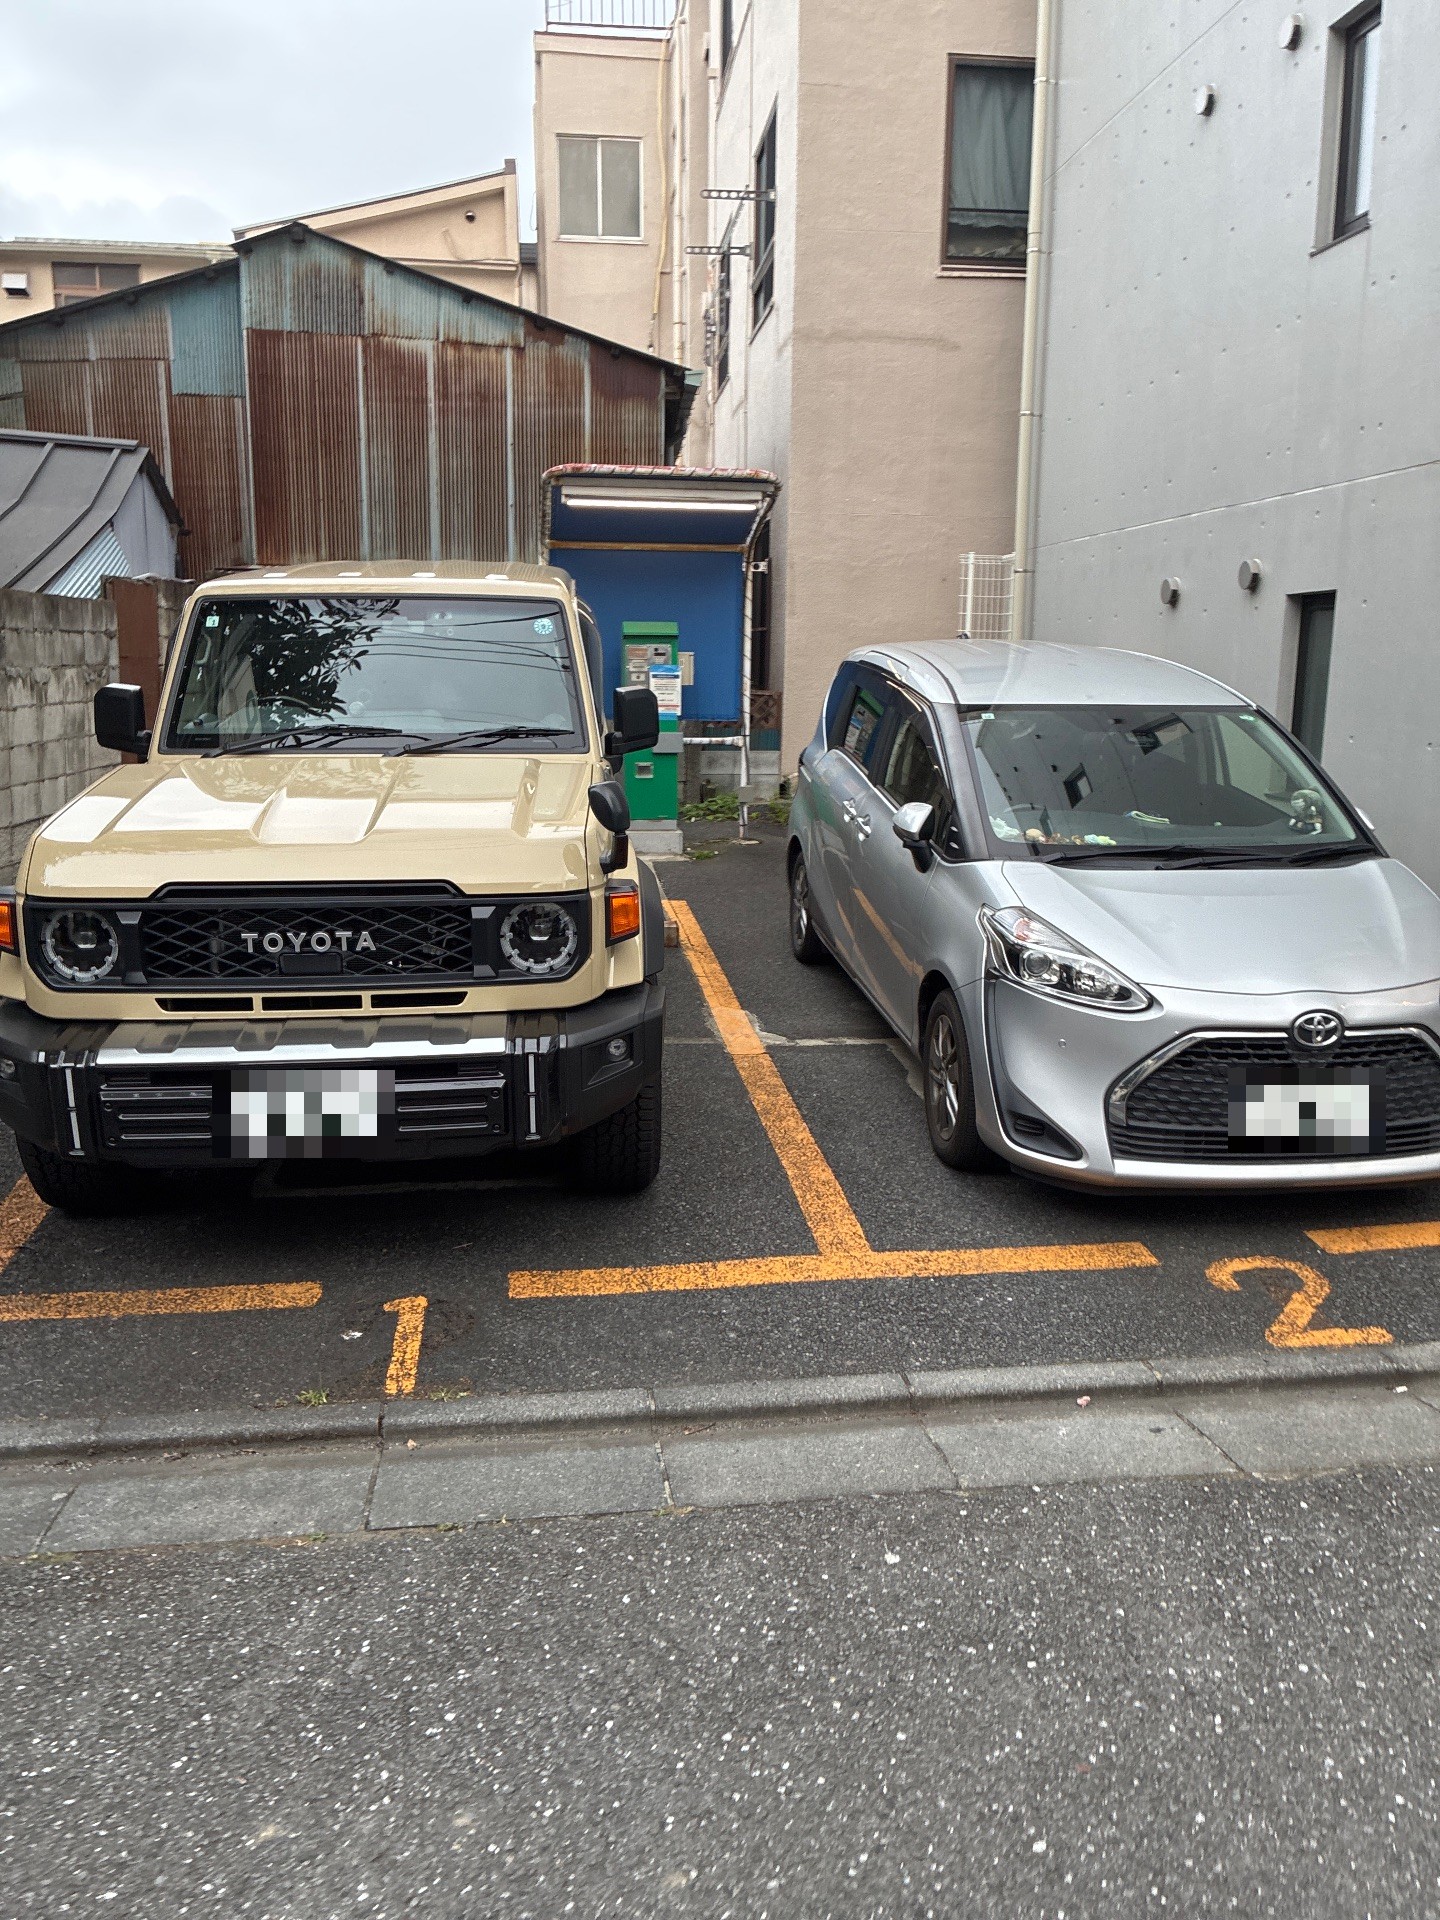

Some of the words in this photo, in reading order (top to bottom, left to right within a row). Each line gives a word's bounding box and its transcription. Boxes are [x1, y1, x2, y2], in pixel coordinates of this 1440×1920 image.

[241, 931, 377, 953] TOYOTA
[383, 1295, 429, 1395] 1
[1205, 1255, 1394, 1348] 2
